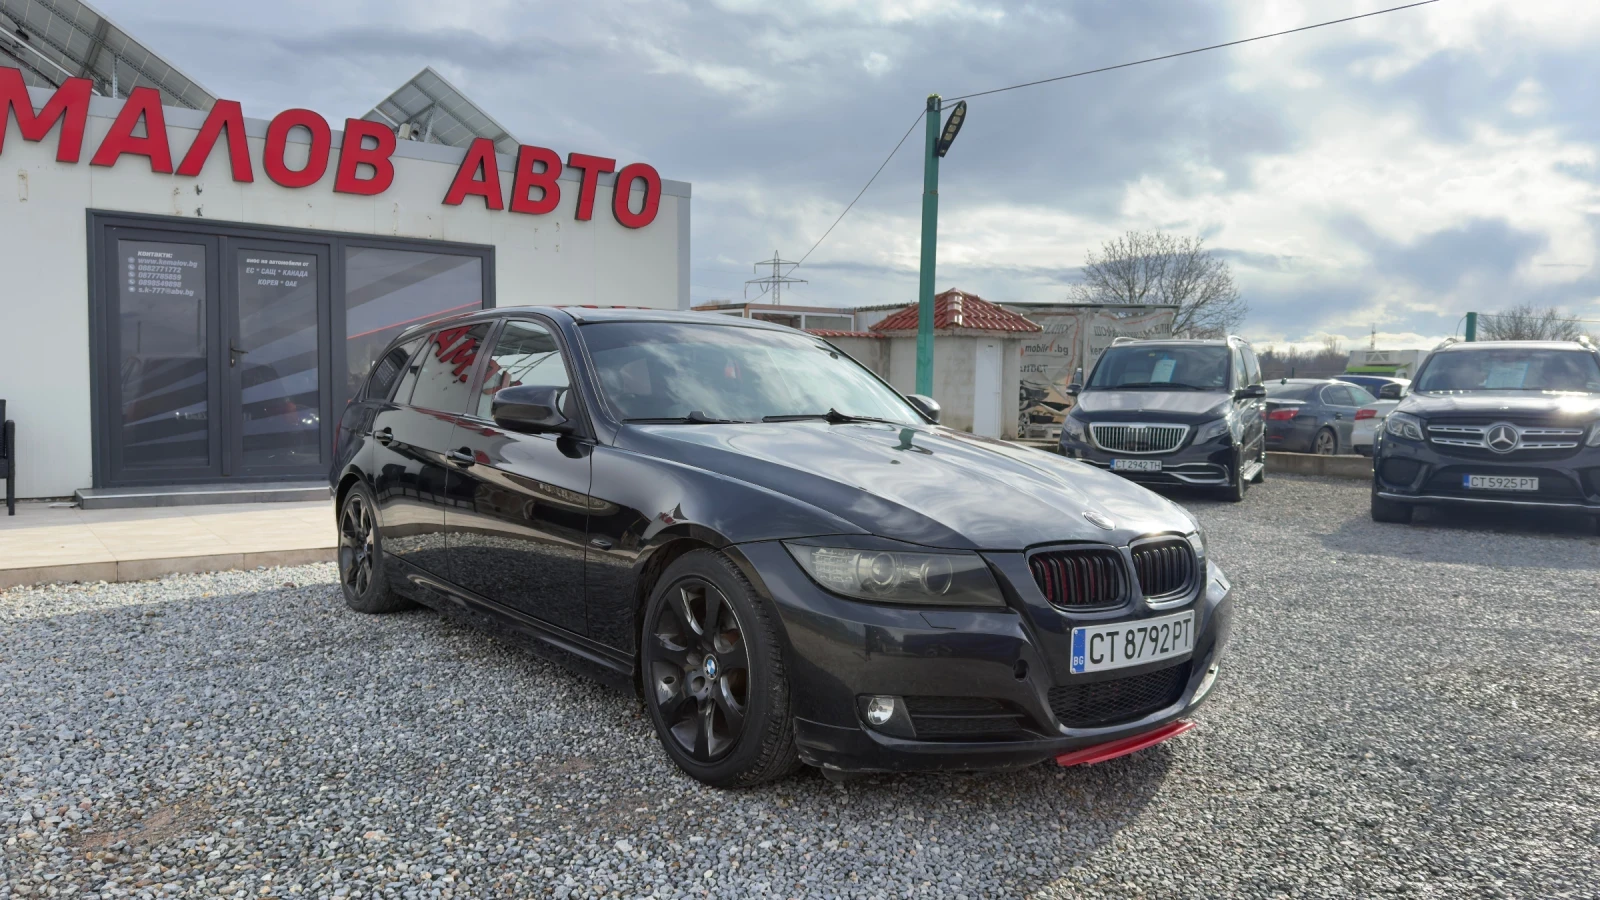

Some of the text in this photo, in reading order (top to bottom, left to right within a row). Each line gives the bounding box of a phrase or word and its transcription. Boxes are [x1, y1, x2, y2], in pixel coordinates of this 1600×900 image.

[0, 66, 662, 229] МАЛОВ АВТО
[260, 268, 276, 276] САЩ
[282, 269, 309, 278] КАНАДА
[257, 278, 279, 286] КОРЕЯ
[1128, 461, 1148, 469] 2942
[1150, 461, 1161, 469] TH
[1471, 476, 1487, 487] CT
[1488, 477, 1518, 488] 5925
[1520, 478, 1537, 488] PT
[1073, 618, 1191, 666] BG CT 8792 PT
